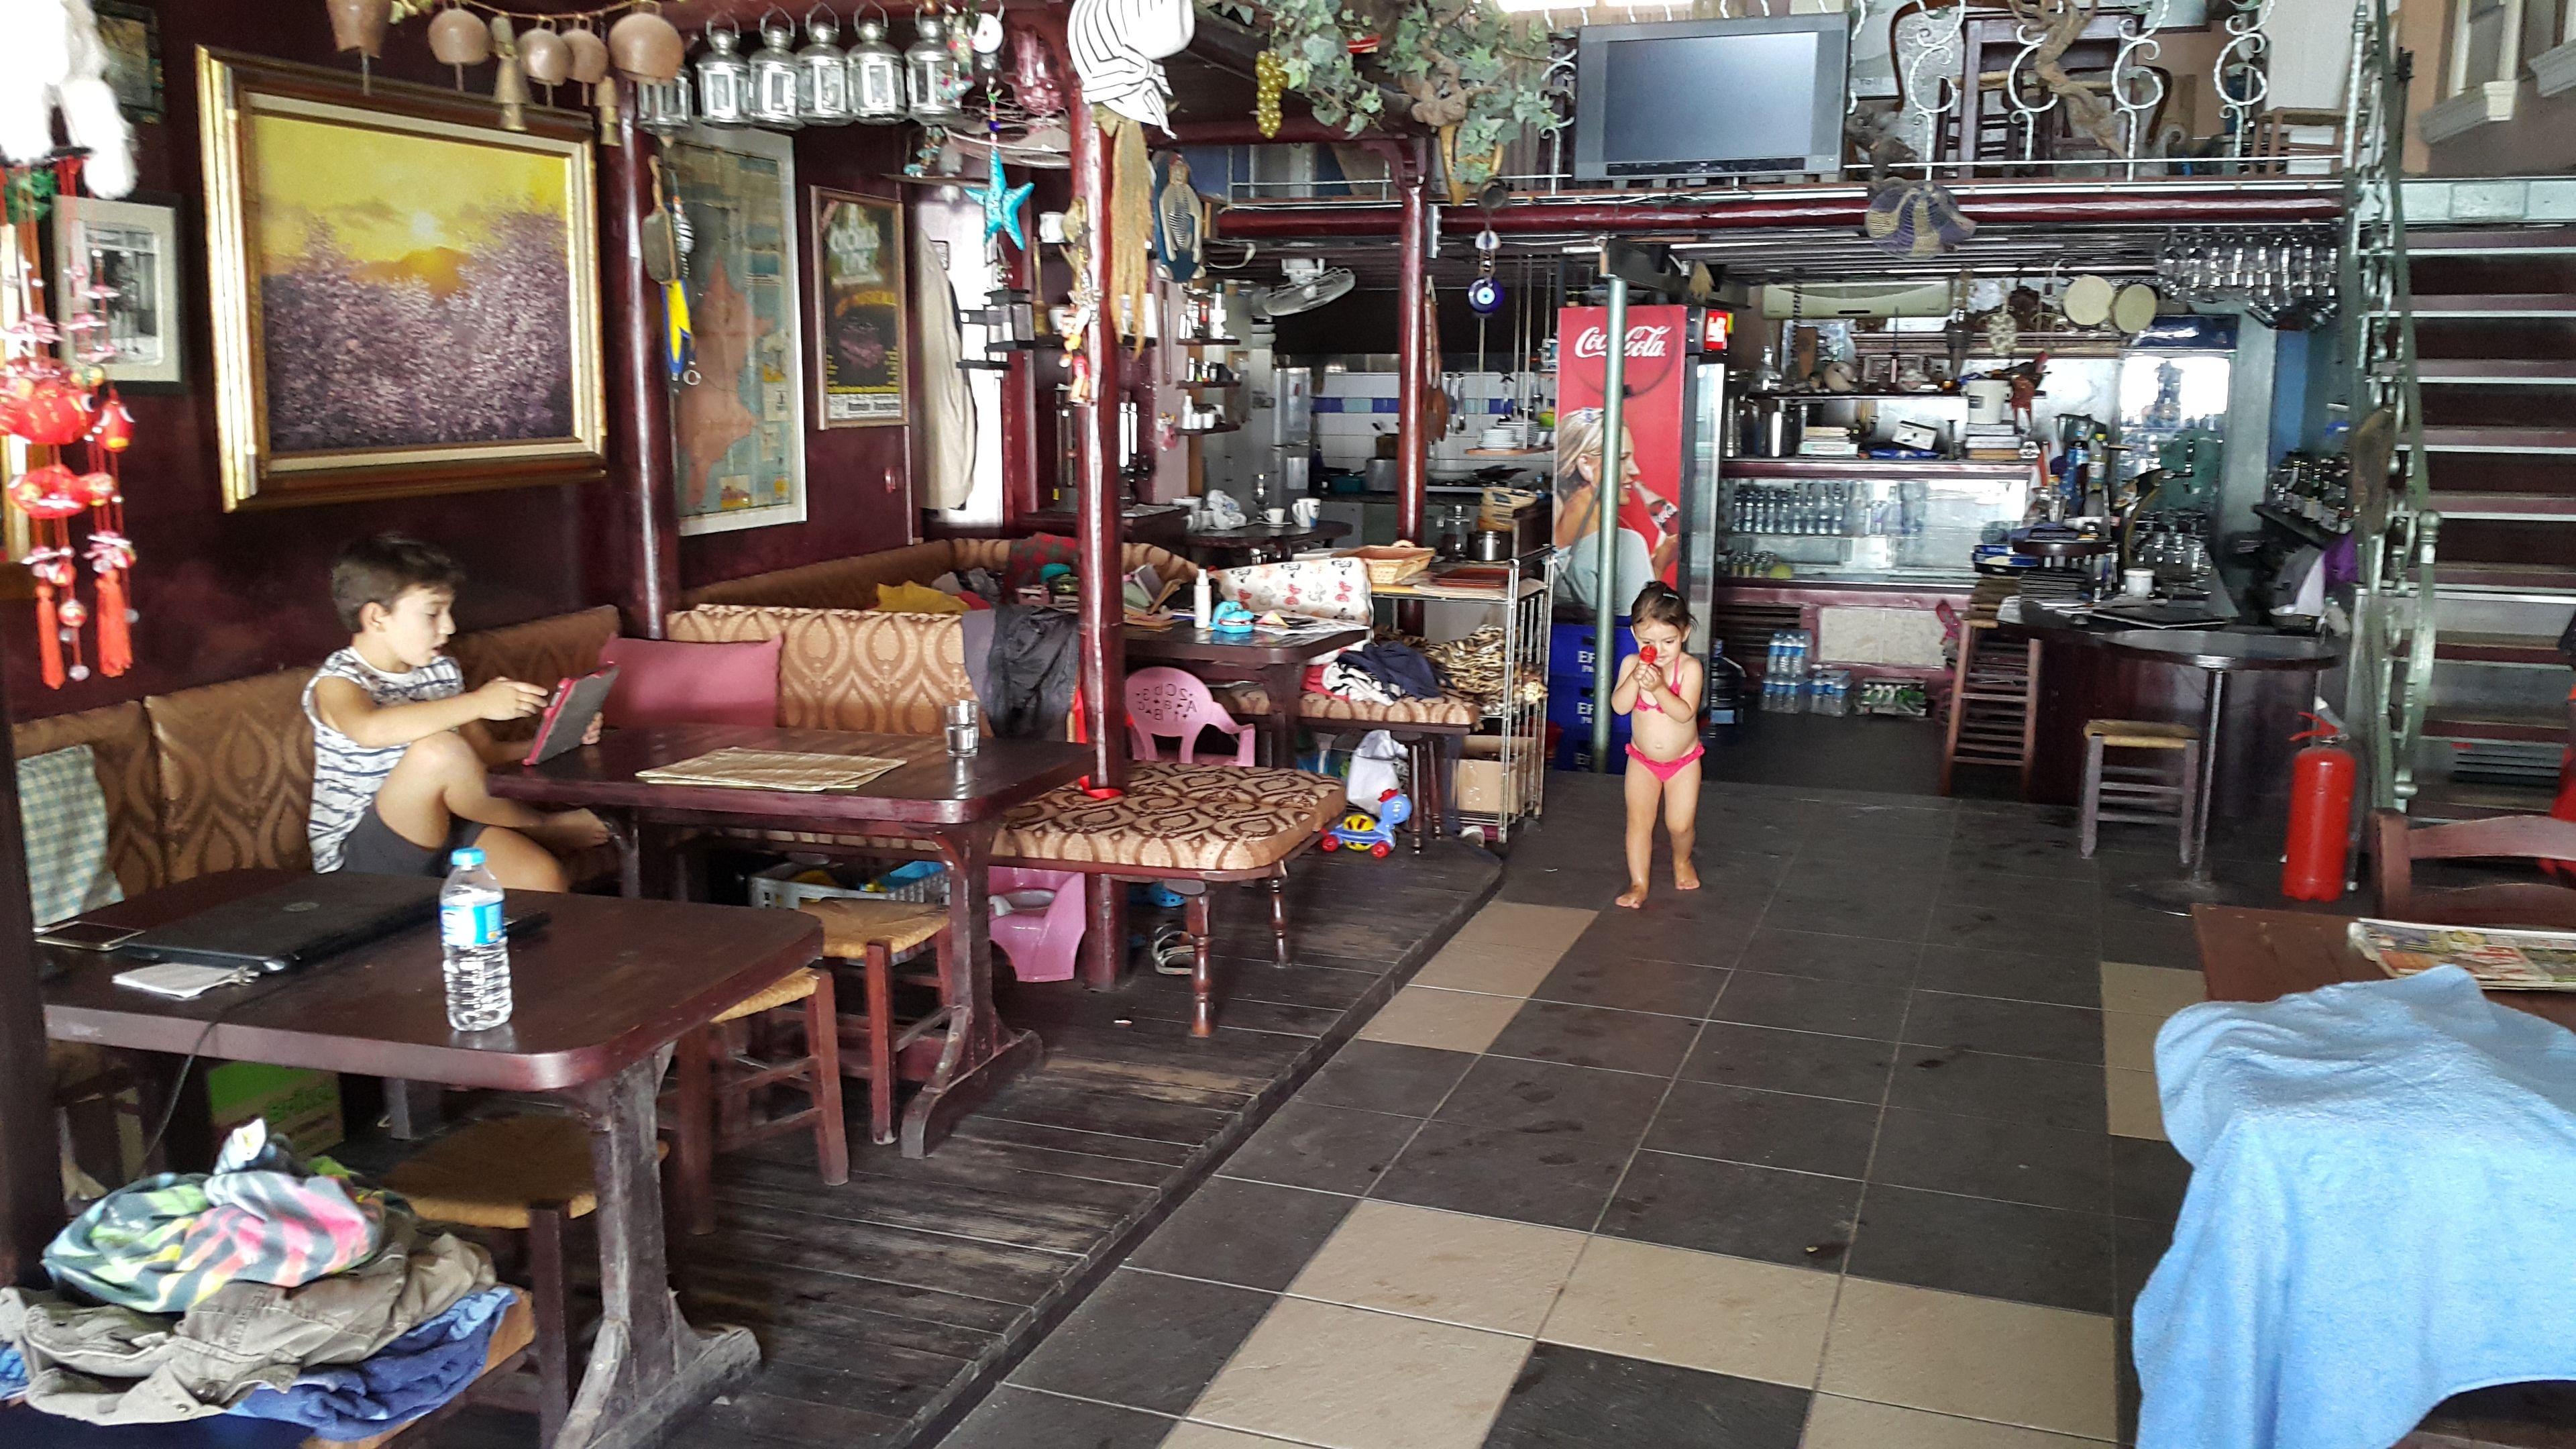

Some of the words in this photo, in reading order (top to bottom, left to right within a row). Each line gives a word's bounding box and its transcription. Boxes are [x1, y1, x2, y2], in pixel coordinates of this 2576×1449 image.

[1574, 325, 1672, 358] CocCola
[1578, 651, 1595, 663] EF
[1576, 702, 1594, 714] EF
